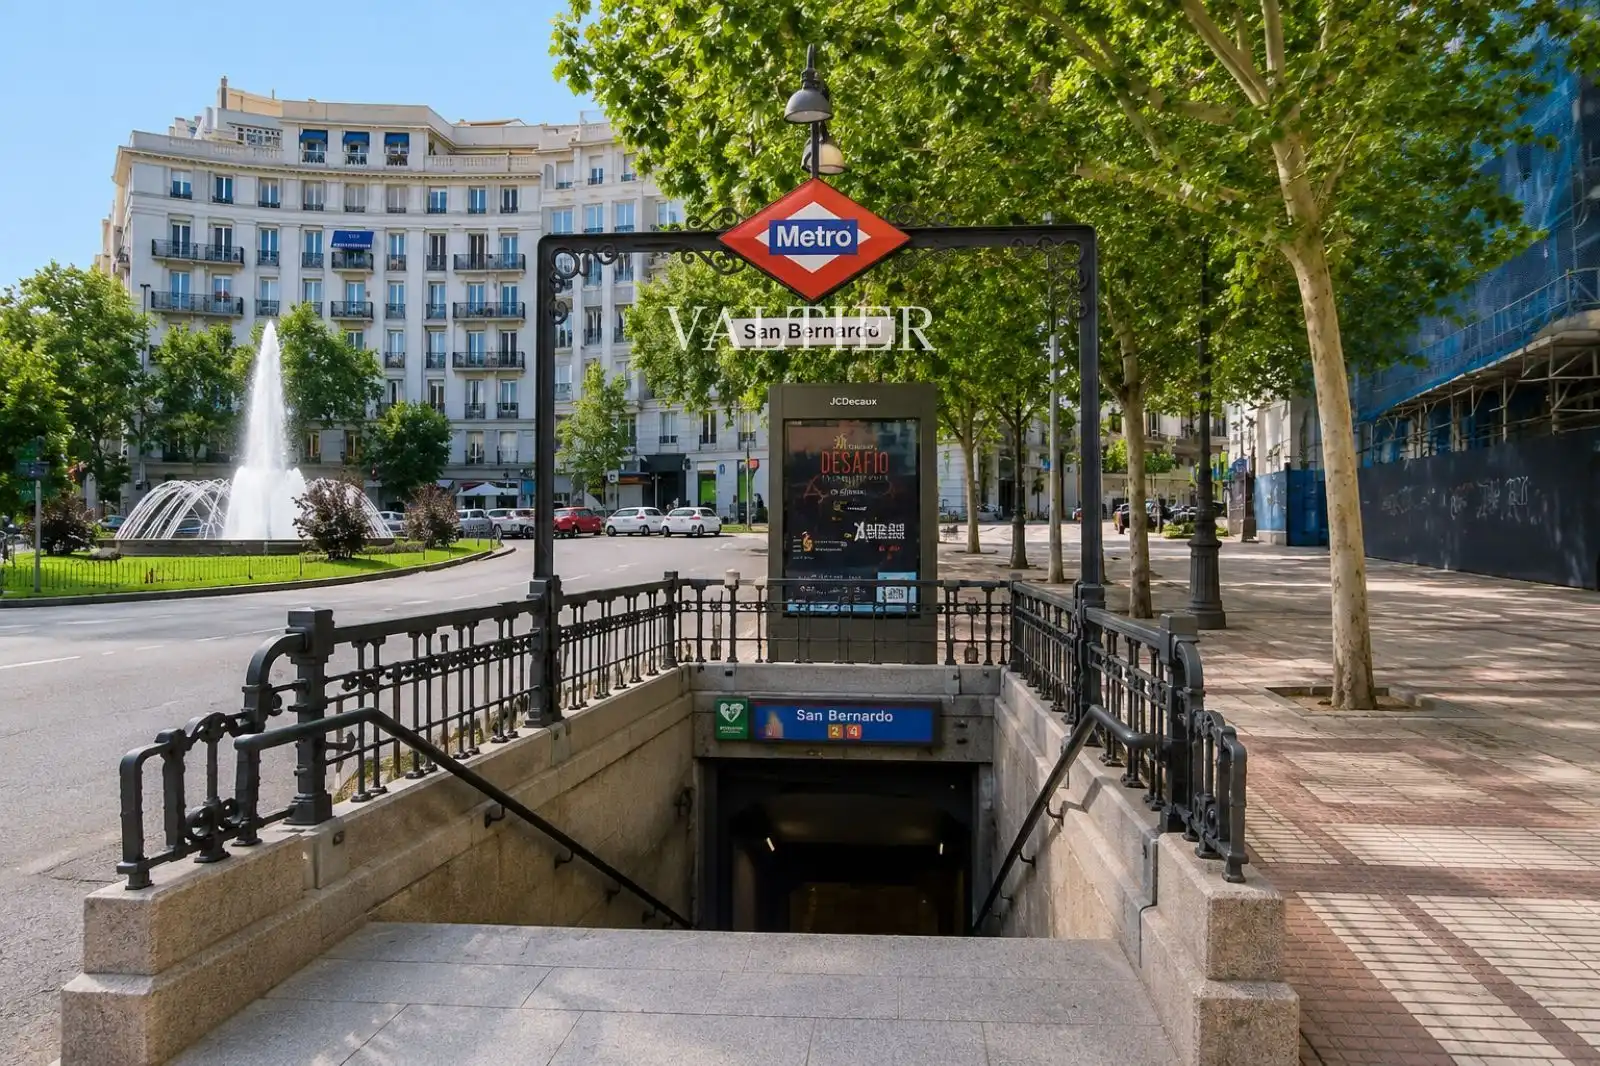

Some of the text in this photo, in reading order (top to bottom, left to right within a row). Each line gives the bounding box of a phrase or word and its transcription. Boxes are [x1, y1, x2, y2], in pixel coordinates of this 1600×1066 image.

[776, 225, 852, 248] Metro
[744, 321, 880, 340] San Bernardo
[829, 397, 878, 407] JCDecaux
[796, 709, 894, 723] San Bernardo
[831, 726, 858, 737] 2 4
